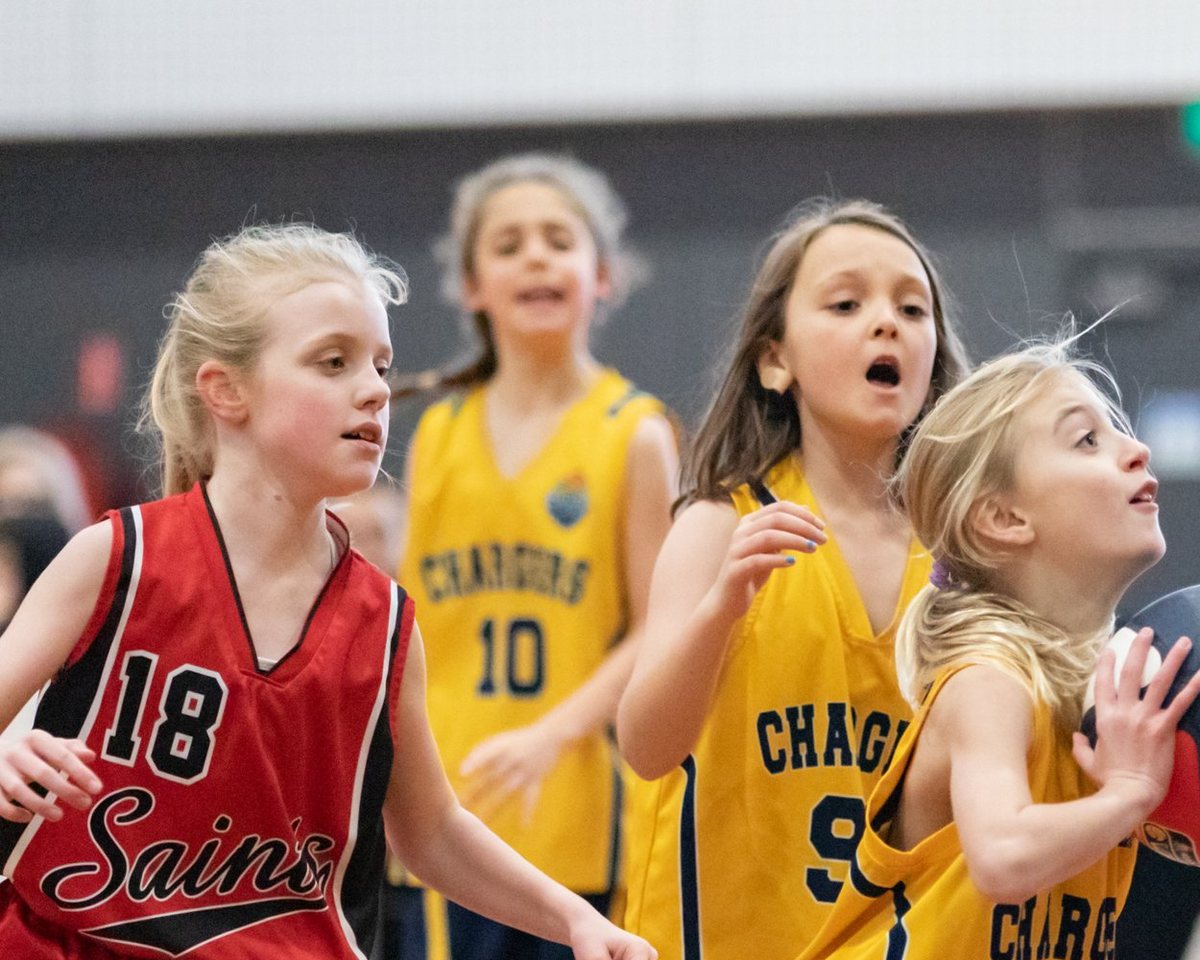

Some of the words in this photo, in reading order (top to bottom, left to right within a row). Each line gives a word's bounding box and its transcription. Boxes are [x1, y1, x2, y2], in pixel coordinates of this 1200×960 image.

[476, 617, 546, 695] 10
[101, 650, 229, 786] 18
[40, 786, 335, 913] Sains
[805, 794, 866, 904] 9
